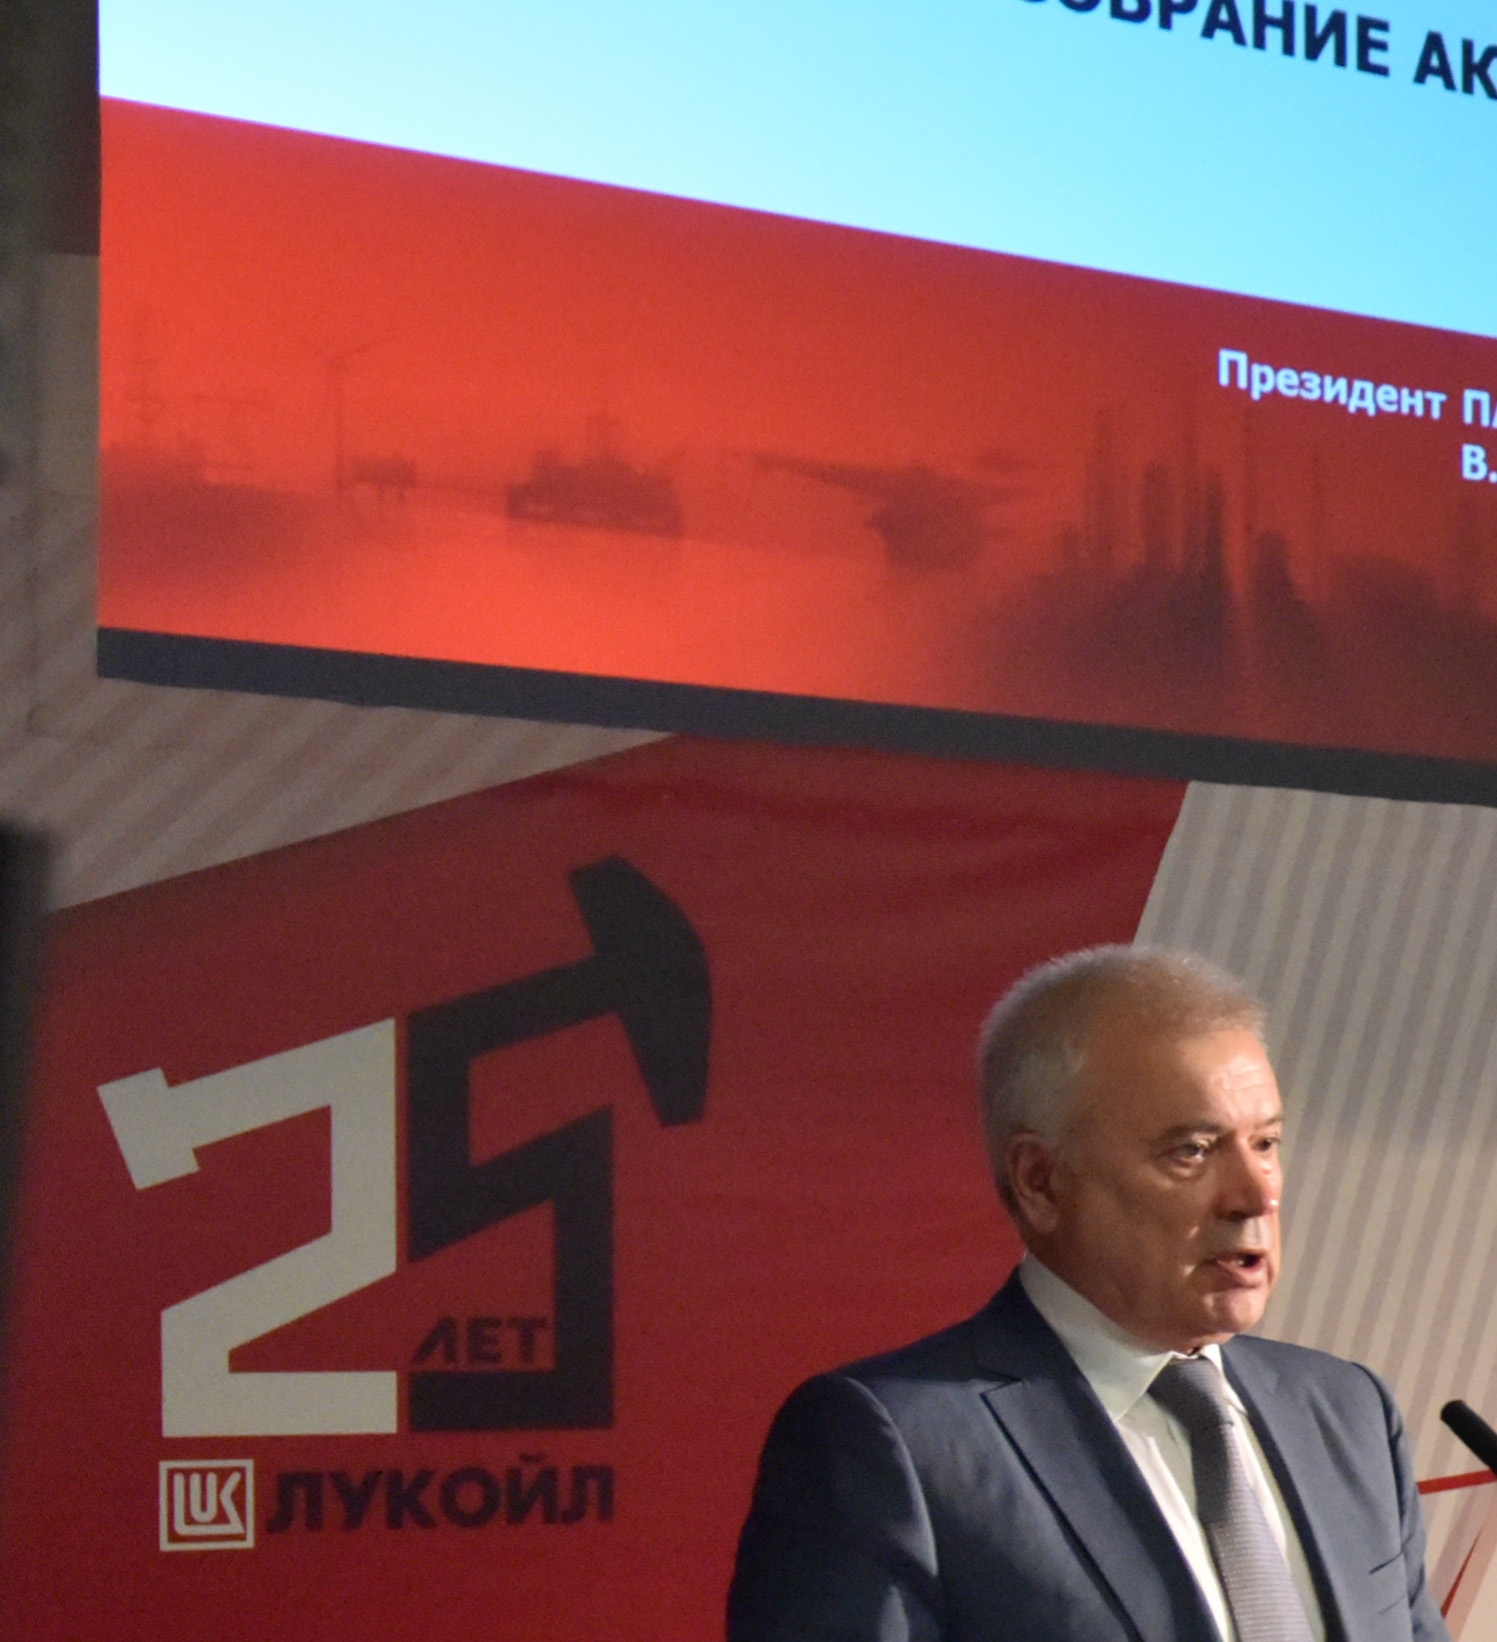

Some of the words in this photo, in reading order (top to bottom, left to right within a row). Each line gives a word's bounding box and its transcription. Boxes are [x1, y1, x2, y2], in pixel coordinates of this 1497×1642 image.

[1218, 348, 1446, 422] Президент
[411, 1316, 547, 1365] ЛЕТ
[267, 1453, 614, 1533] ЛУКОЙЛ
